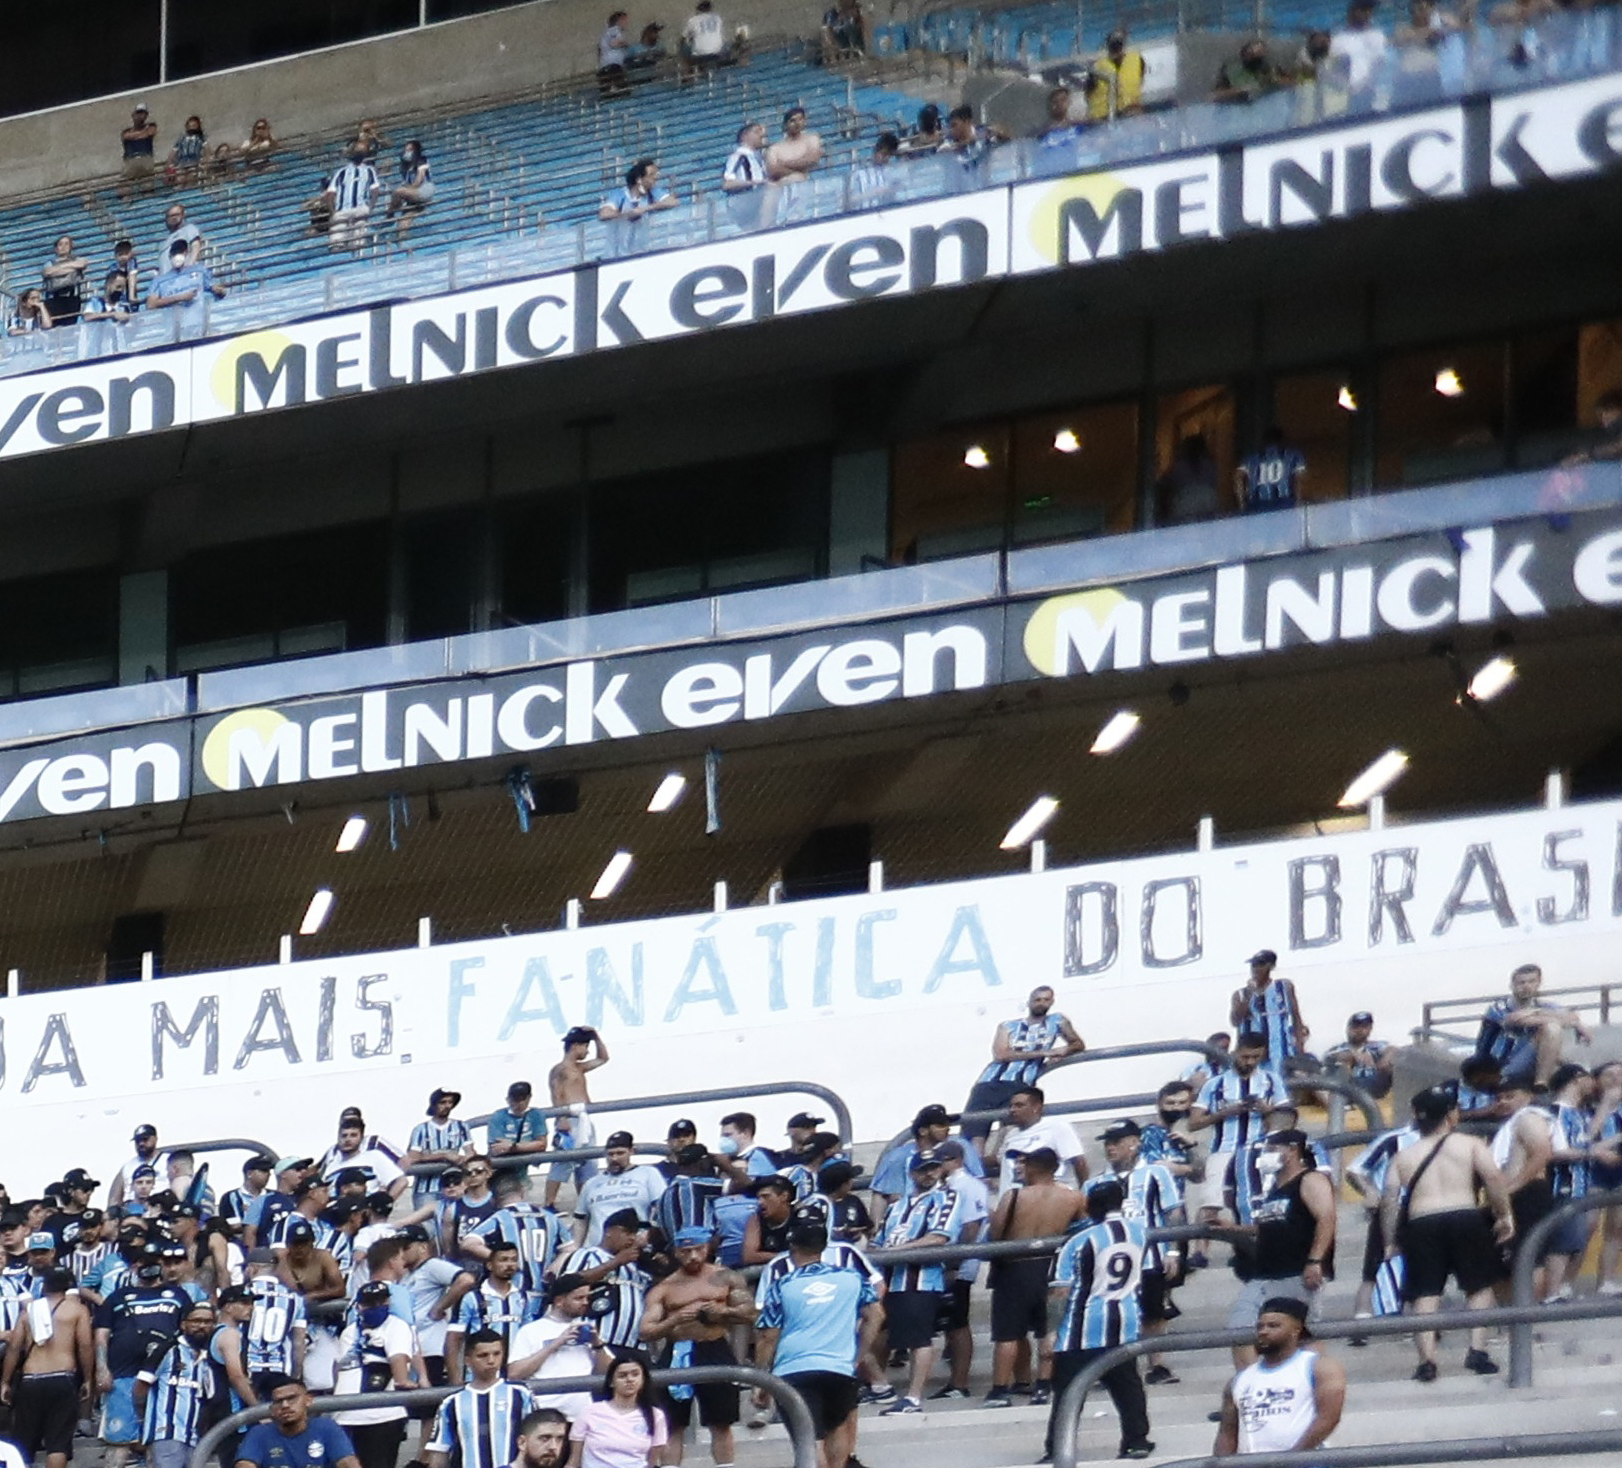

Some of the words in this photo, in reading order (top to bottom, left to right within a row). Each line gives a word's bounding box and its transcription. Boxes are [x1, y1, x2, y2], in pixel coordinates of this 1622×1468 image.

[150, 973, 393, 1083] MAIS
[446, 903, 1003, 1048] FANÁTICA
[1064, 876, 1202, 980] DO
[1108, 1252, 1132, 1291] 9
